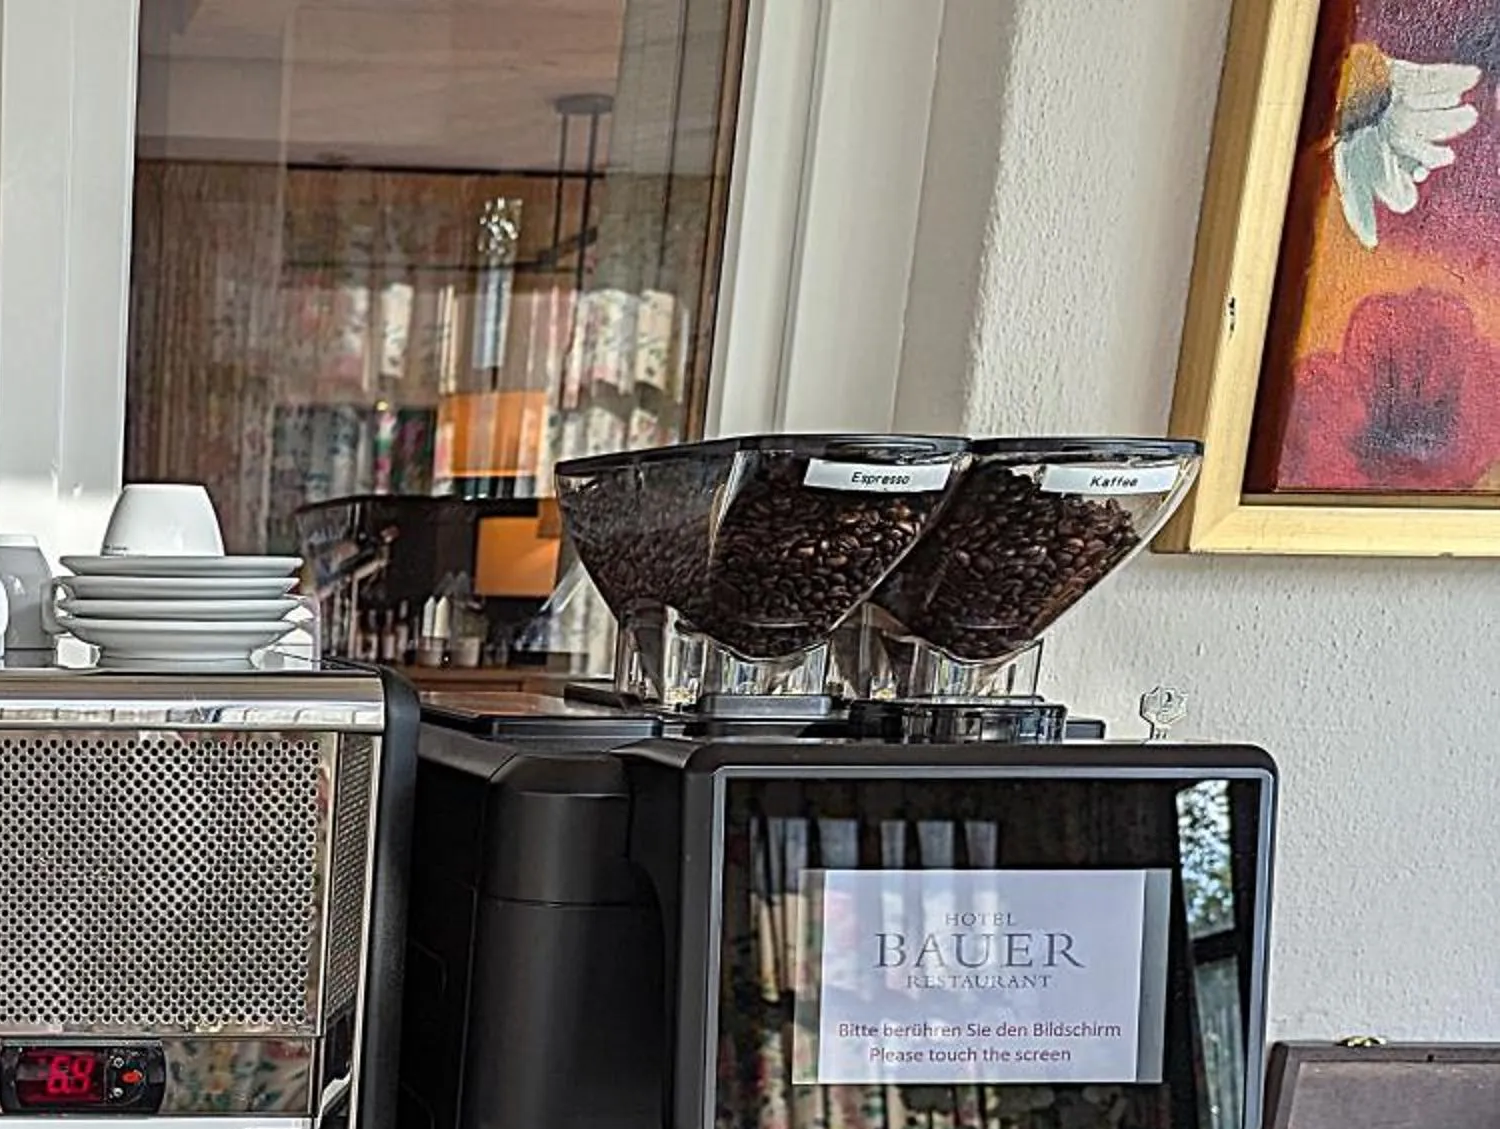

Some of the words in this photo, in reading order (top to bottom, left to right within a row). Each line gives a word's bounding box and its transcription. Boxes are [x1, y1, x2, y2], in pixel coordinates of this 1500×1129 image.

[851, 470, 911, 487] Espresso
[1090, 475, 1139, 489] Kaffee
[945, 912, 1017, 927] HOTEL
[874, 932, 1086, 968] BAUER
[907, 974, 1052, 989] RESTAURANT
[839, 1022, 879, 1038] Bitte
[883, 1022, 962, 1038] berühren
[967, 1022, 991, 1038] Sie
[996, 1022, 1028, 1038] den
[1033, 1022, 1121, 1038] Bildschirm
[870, 1047, 924, 1063] Please
[929, 1047, 977, 1063] touch
[983, 1047, 1011, 1063] the
[1015, 1050, 1071, 1063] screen
